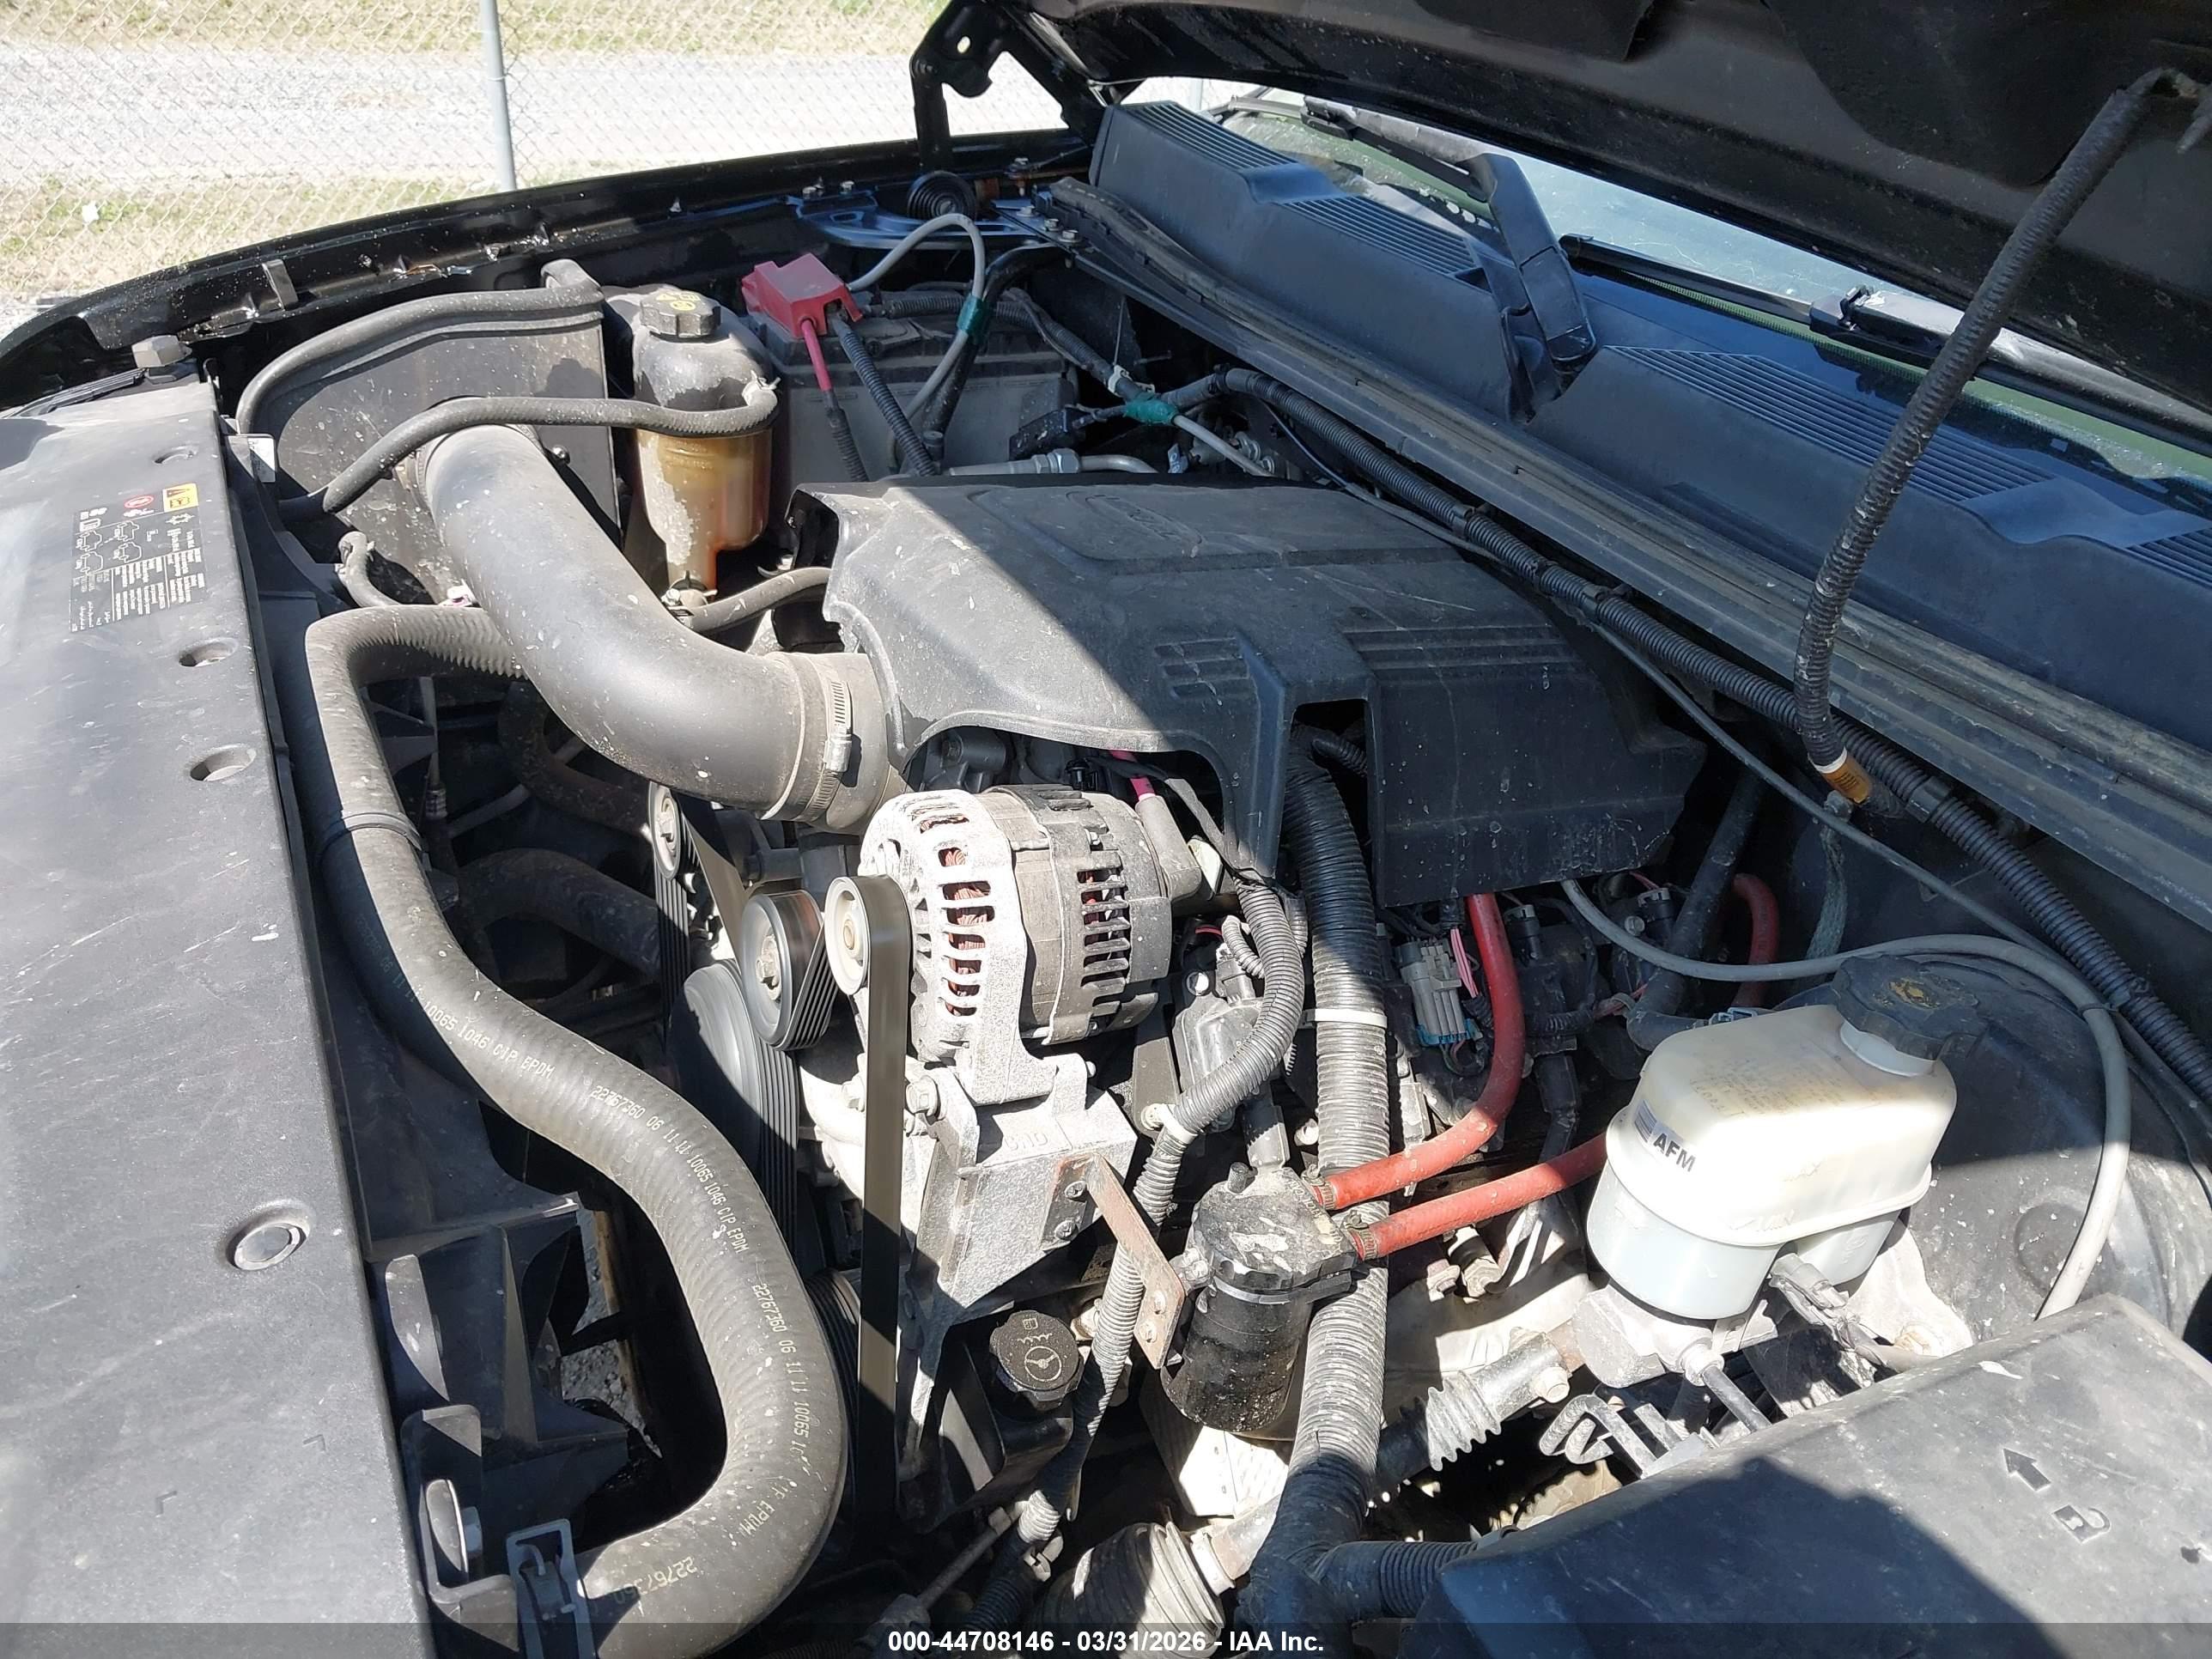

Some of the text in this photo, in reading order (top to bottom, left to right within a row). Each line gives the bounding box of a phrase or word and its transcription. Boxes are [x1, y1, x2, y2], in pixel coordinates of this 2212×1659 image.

[423, 1000, 459, 1031] 10065
[457, 1025, 490, 1048] 1046
[521, 1056, 556, 1079] EPDM
[590, 1085, 646, 1120] 22767360
[646, 1115, 665, 1132] 06
[686, 1154, 715, 1184] 10065
[703, 1182, 727, 1206] 1046
[726, 1227, 750, 1255] EPDM
[1653, 1133, 1696, 1172] AFM
[752, 1284, 787, 1334] 22767360
[779, 1340, 797, 1354] 06
[793, 1401, 811, 1438] 10065
